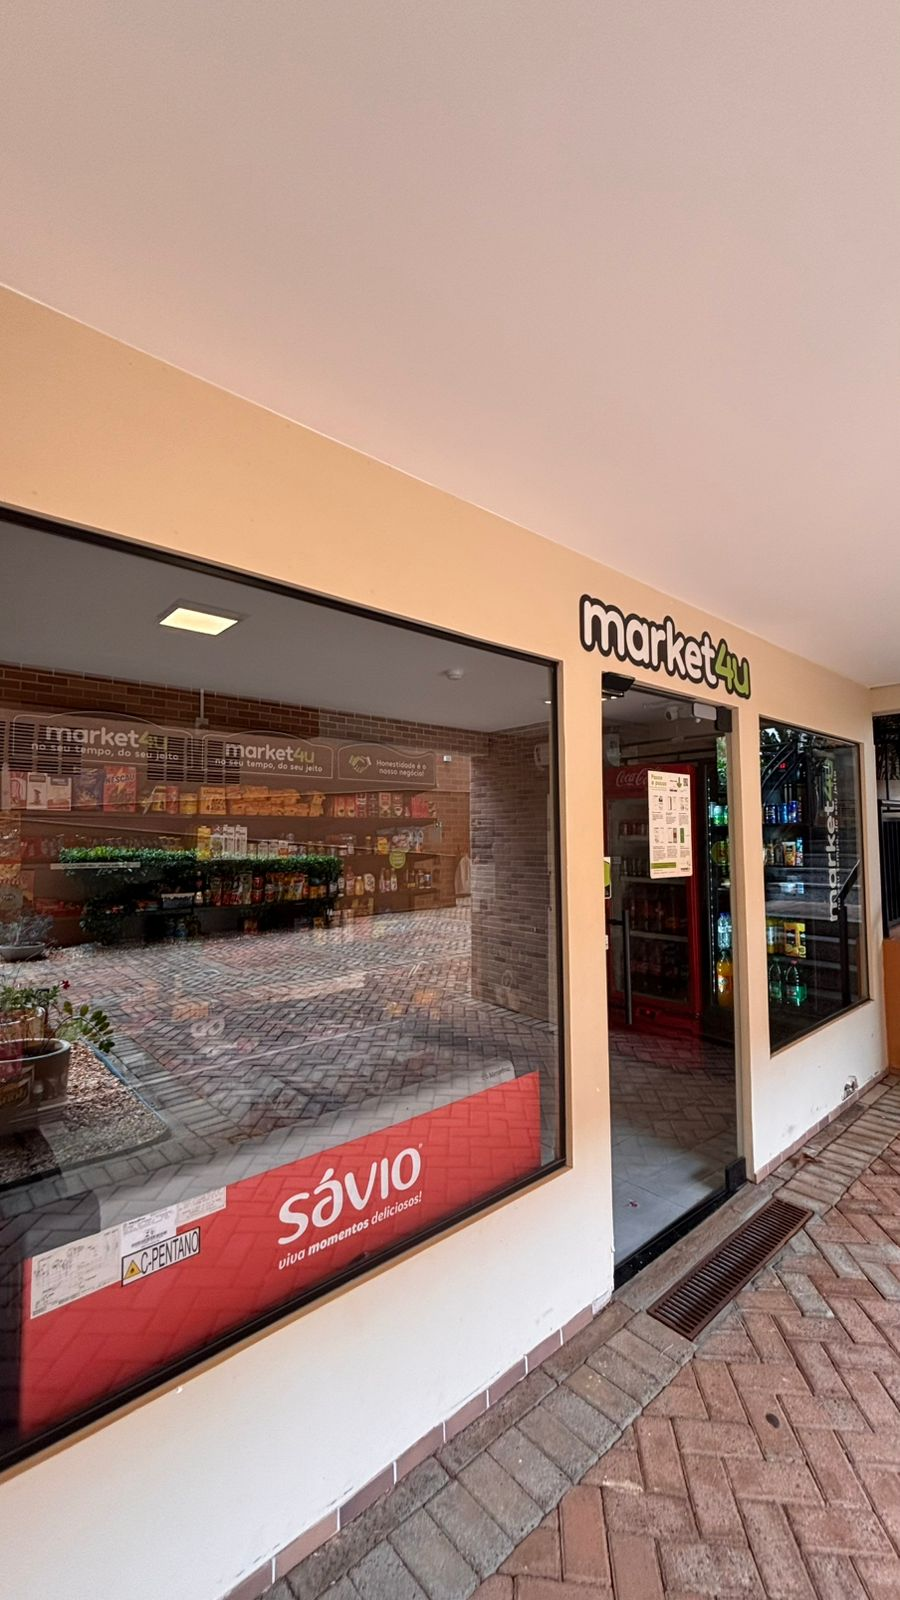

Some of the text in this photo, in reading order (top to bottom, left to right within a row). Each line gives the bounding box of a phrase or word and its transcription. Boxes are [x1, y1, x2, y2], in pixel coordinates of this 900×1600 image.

[580, 595, 750, 698] market4u
[45, 726, 168, 751] market4u
[75, 745, 114, 758] tempo,
[118, 748, 131, 757] do
[155, 752, 180, 761] jeito
[226, 744, 315, 763] market4u
[246, 760, 276, 770] tempo,
[305, 764, 323, 772] jeito
[376, 760, 416, 770] Honestidade
[278, 1190, 423, 1270] viva momentos deliciosos!
[140, 1230, 200, 1275] C-PENTANO
